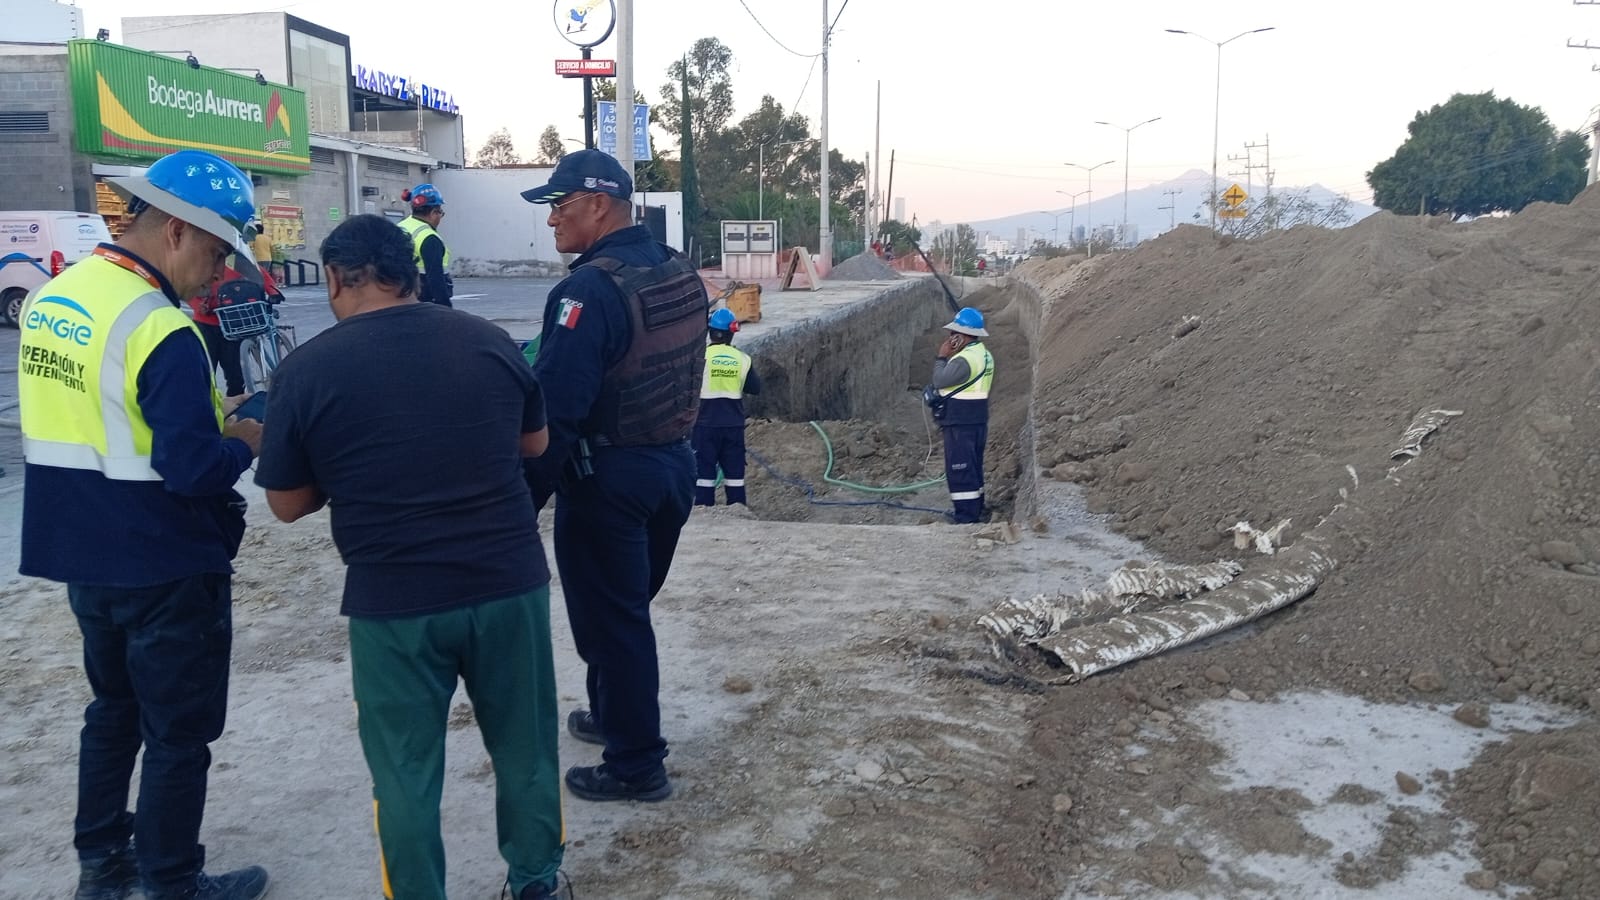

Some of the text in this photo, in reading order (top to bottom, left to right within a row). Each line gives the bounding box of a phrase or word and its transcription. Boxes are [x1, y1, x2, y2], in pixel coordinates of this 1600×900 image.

[147, 75, 264, 123] Bodega Aurrera
[77, 363, 85, 379] Y
